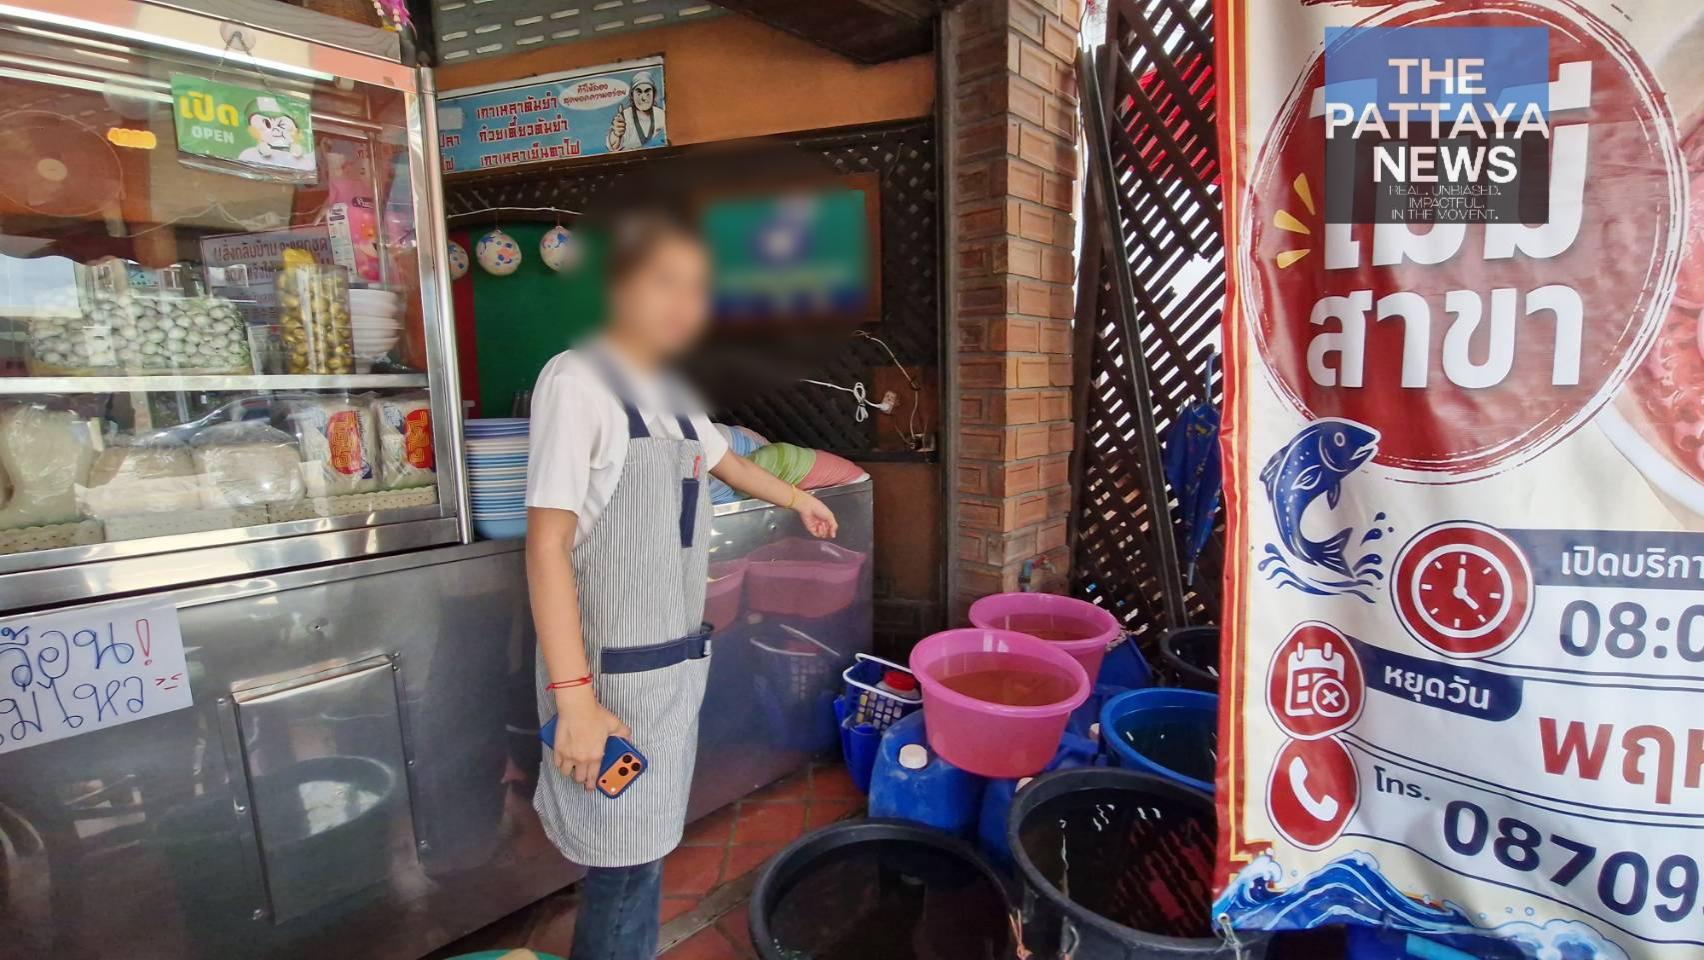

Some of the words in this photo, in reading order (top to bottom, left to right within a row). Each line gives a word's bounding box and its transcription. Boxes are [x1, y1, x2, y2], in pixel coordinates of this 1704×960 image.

[179, 90, 240, 127] เปิด
[476, 92, 558, 120] เกาเหลาต้มยำ
[191, 125, 235, 145] OPEN
[478, 115, 569, 143] ก๋วยเตี๋ยวต้มยำ
[1306, 284, 1584, 389] สาขา
[1559, 599, 1704, 663] 08:0
[1384, 665, 1491, 710] หยุดวัน
[1373, 765, 1431, 801] โทร.
[1443, 799, 1704, 924] 08709
